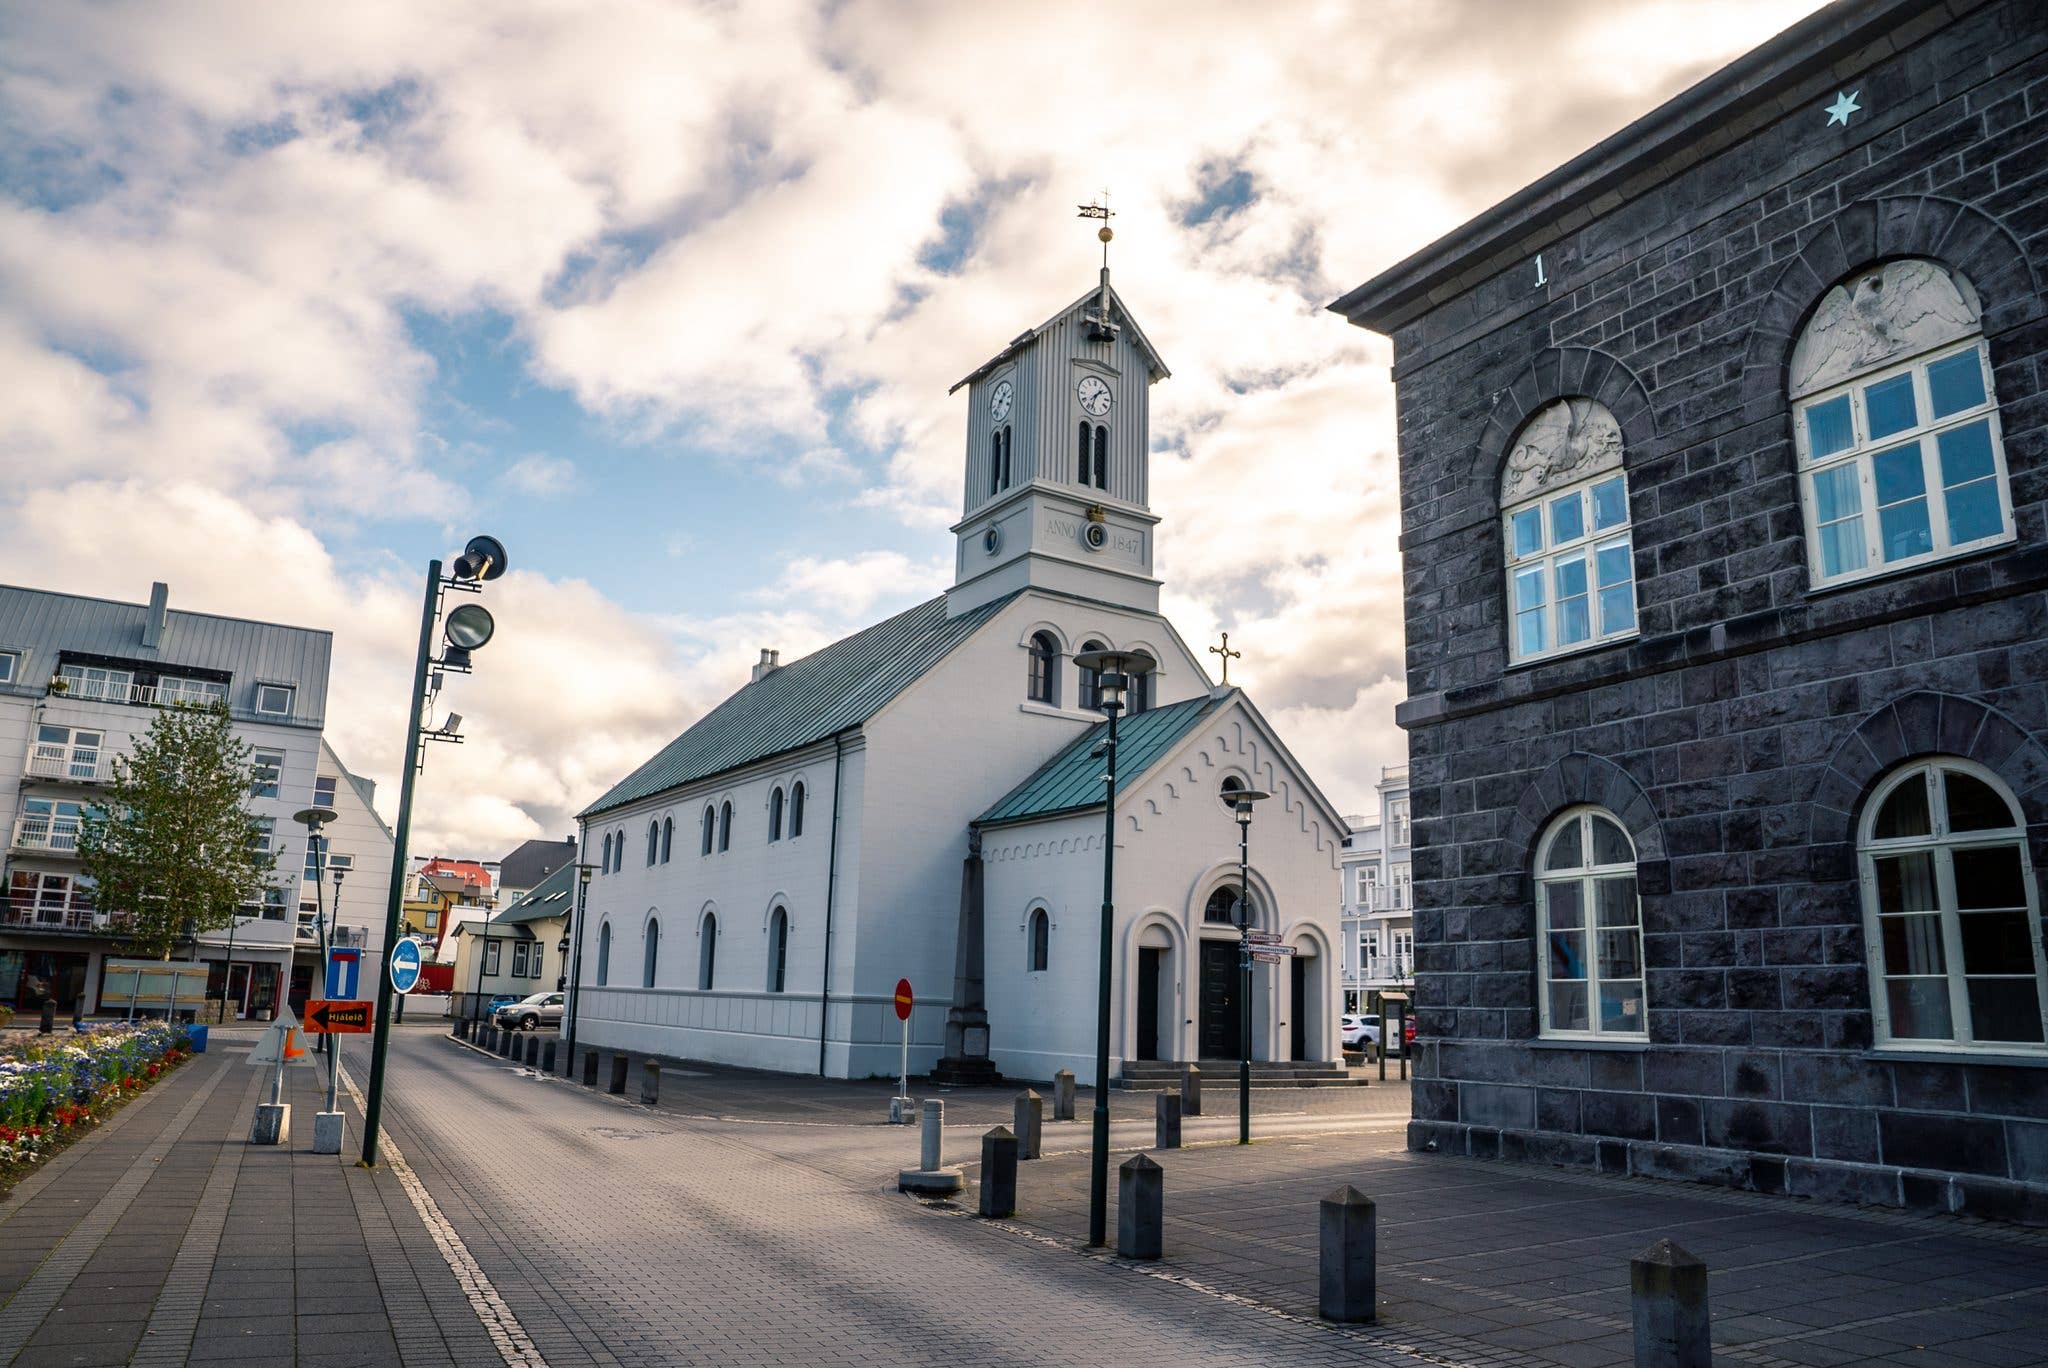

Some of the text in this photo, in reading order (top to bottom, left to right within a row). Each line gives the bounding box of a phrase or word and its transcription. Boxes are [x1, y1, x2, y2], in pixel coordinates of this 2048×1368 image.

[1534, 254, 1547, 287] 1
[1046, 519, 1076, 539] ANNO
[1113, 536, 1138, 554] 1847
